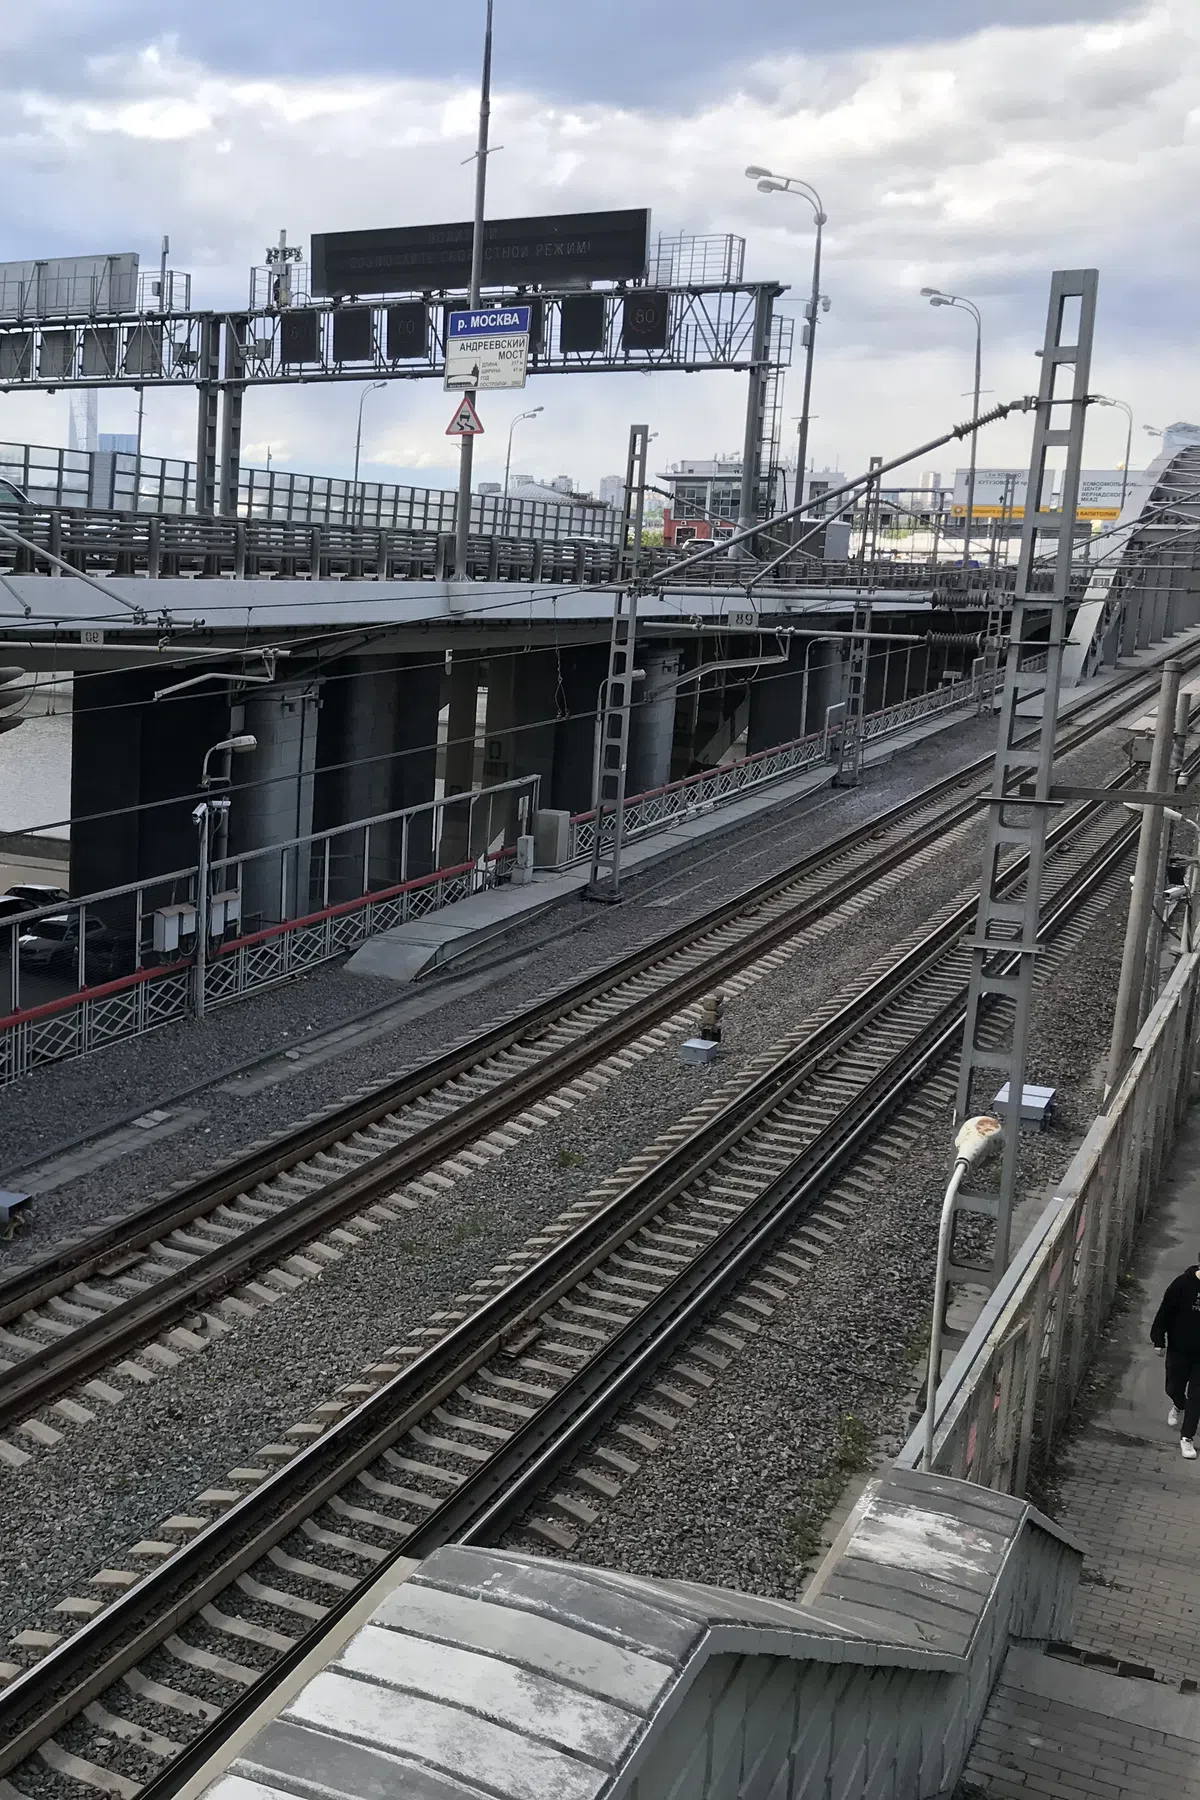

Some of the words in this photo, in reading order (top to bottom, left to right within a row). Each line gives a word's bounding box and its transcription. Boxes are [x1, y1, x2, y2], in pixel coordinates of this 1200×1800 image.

[440, 245, 529, 264] СКОРСТНОЙ
[457, 319, 468, 332] р.
[470, 312, 520, 328] МОСКВА
[635, 308, 655, 324] 80
[459, 337, 526, 352] АНДРЕЕВСКИЙ
[498, 349, 525, 360] МОСТ
[735, 613, 753, 626] 89
